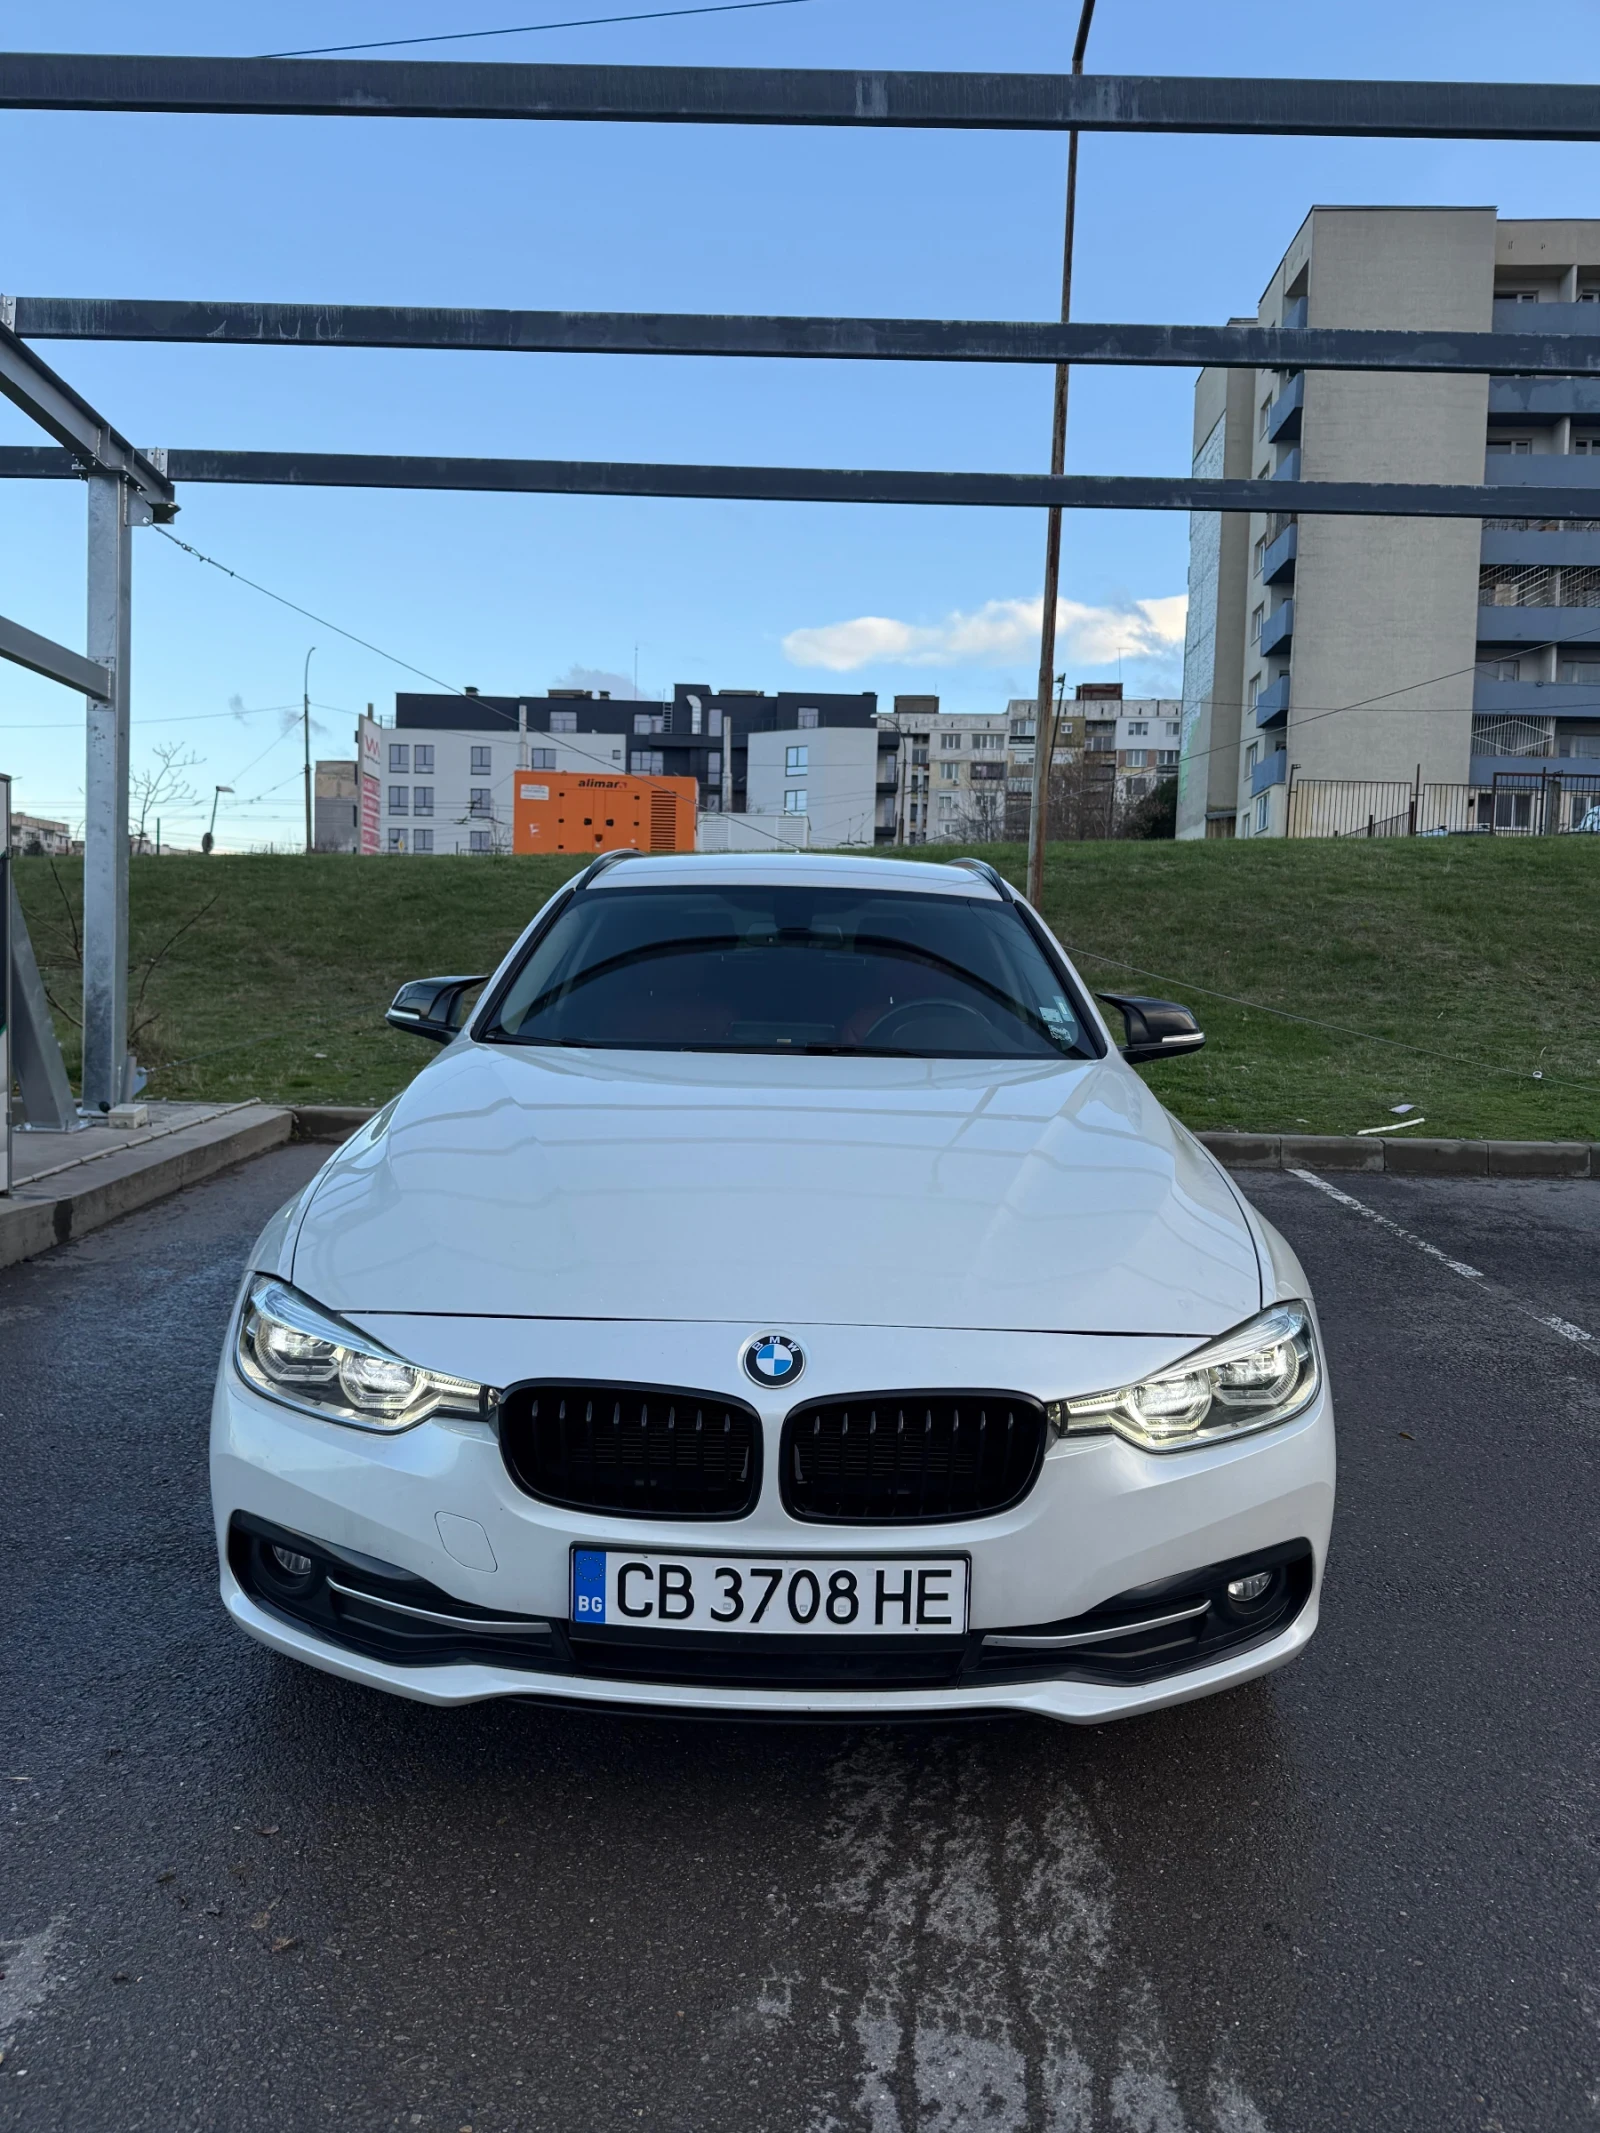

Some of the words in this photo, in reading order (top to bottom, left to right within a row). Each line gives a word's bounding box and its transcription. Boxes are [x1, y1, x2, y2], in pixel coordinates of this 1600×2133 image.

[752, 1336, 800, 1353] BMW
[617, 1562, 695, 1620] CB
[710, 1567, 859, 1624] 3708
[874, 1569, 952, 1625] HE
[578, 1595, 603, 1613] BG
